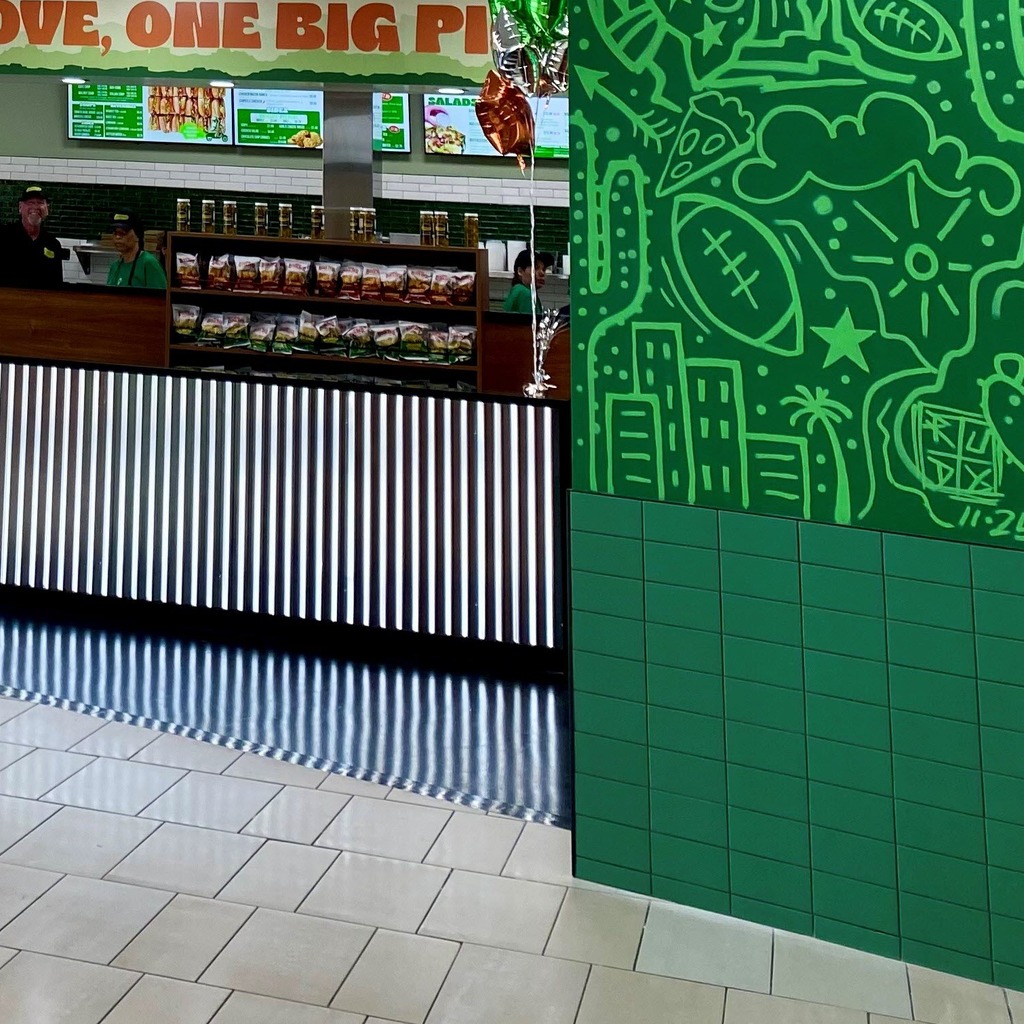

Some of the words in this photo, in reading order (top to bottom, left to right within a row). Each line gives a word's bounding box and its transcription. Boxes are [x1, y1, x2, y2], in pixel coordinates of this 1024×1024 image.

[125, 0, 262, 50] ONE
[276, 2, 400, 53] BIG
[416, 4, 489, 56] PI
